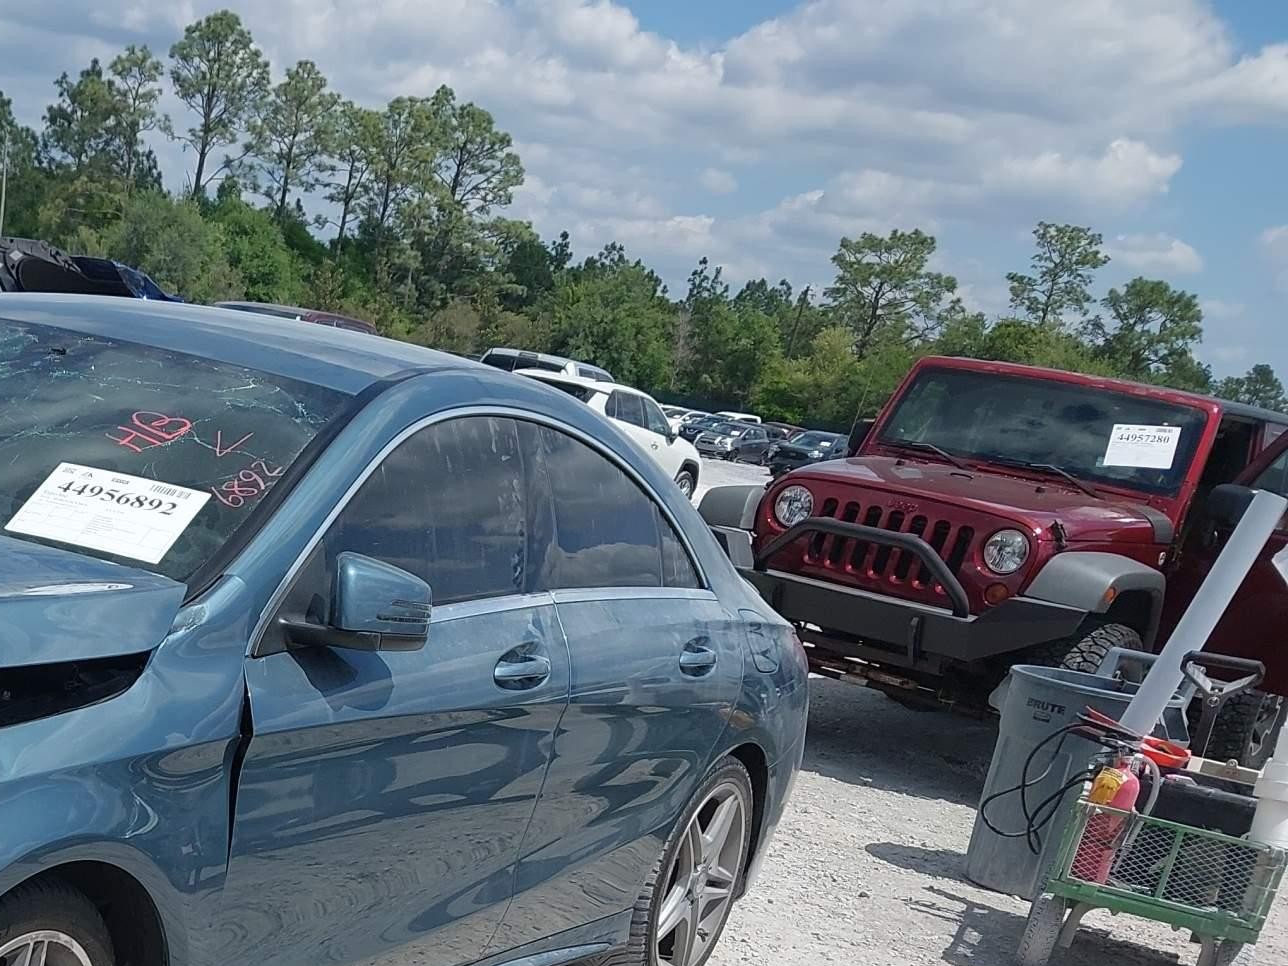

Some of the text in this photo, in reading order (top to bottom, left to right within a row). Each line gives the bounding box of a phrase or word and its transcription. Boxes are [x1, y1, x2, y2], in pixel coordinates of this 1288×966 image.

[1117, 433, 1170, 443] 44957280
[211, 460, 284, 508] 6892
[57, 480, 178, 516] 44956892
[1026, 698, 1066, 715] BRUTE
